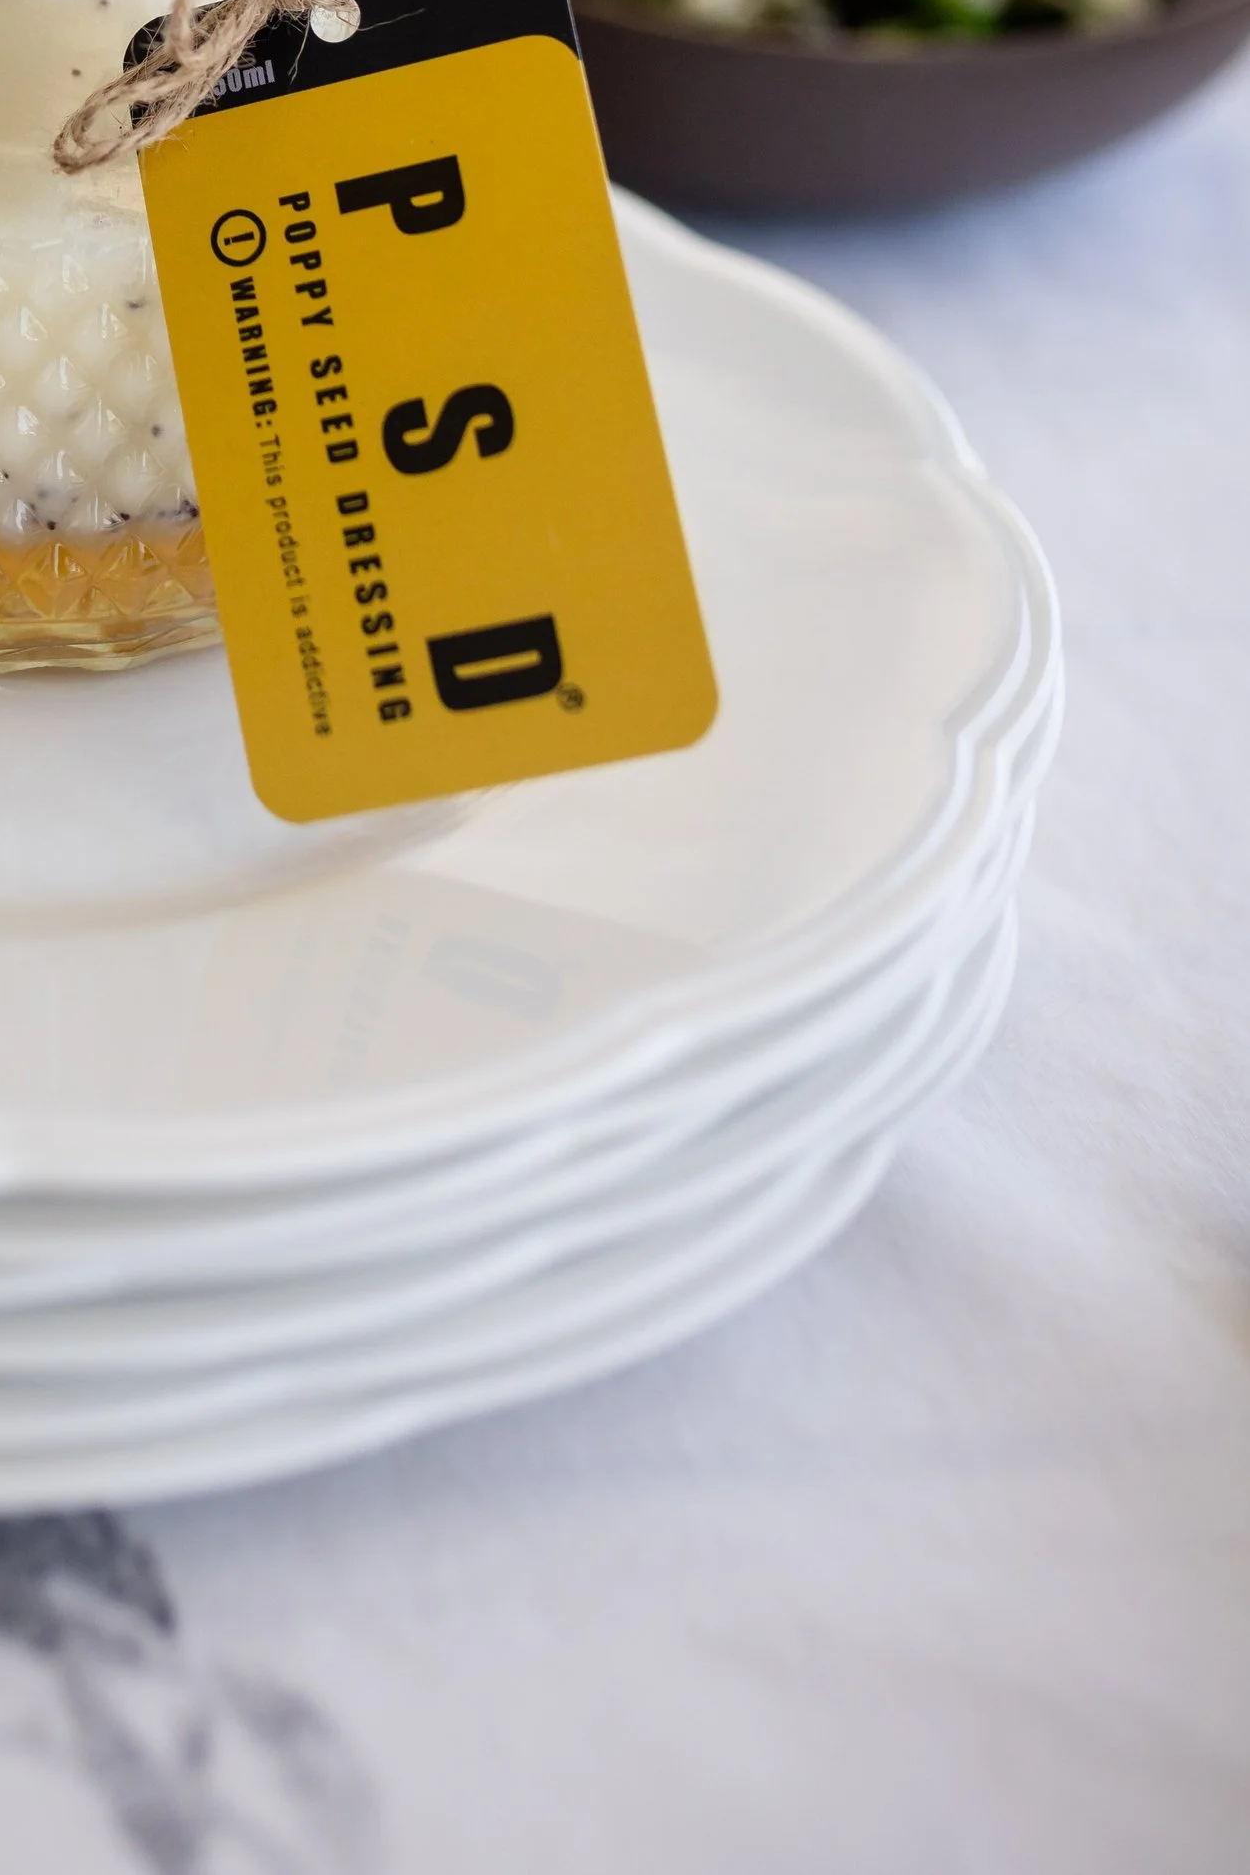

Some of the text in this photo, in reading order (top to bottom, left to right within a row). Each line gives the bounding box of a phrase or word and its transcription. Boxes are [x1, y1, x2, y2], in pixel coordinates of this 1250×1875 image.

[230, 275, 333, 737] WARNING: This product is addictive
[278, 190, 414, 726] POPPY SEED DRESSING
